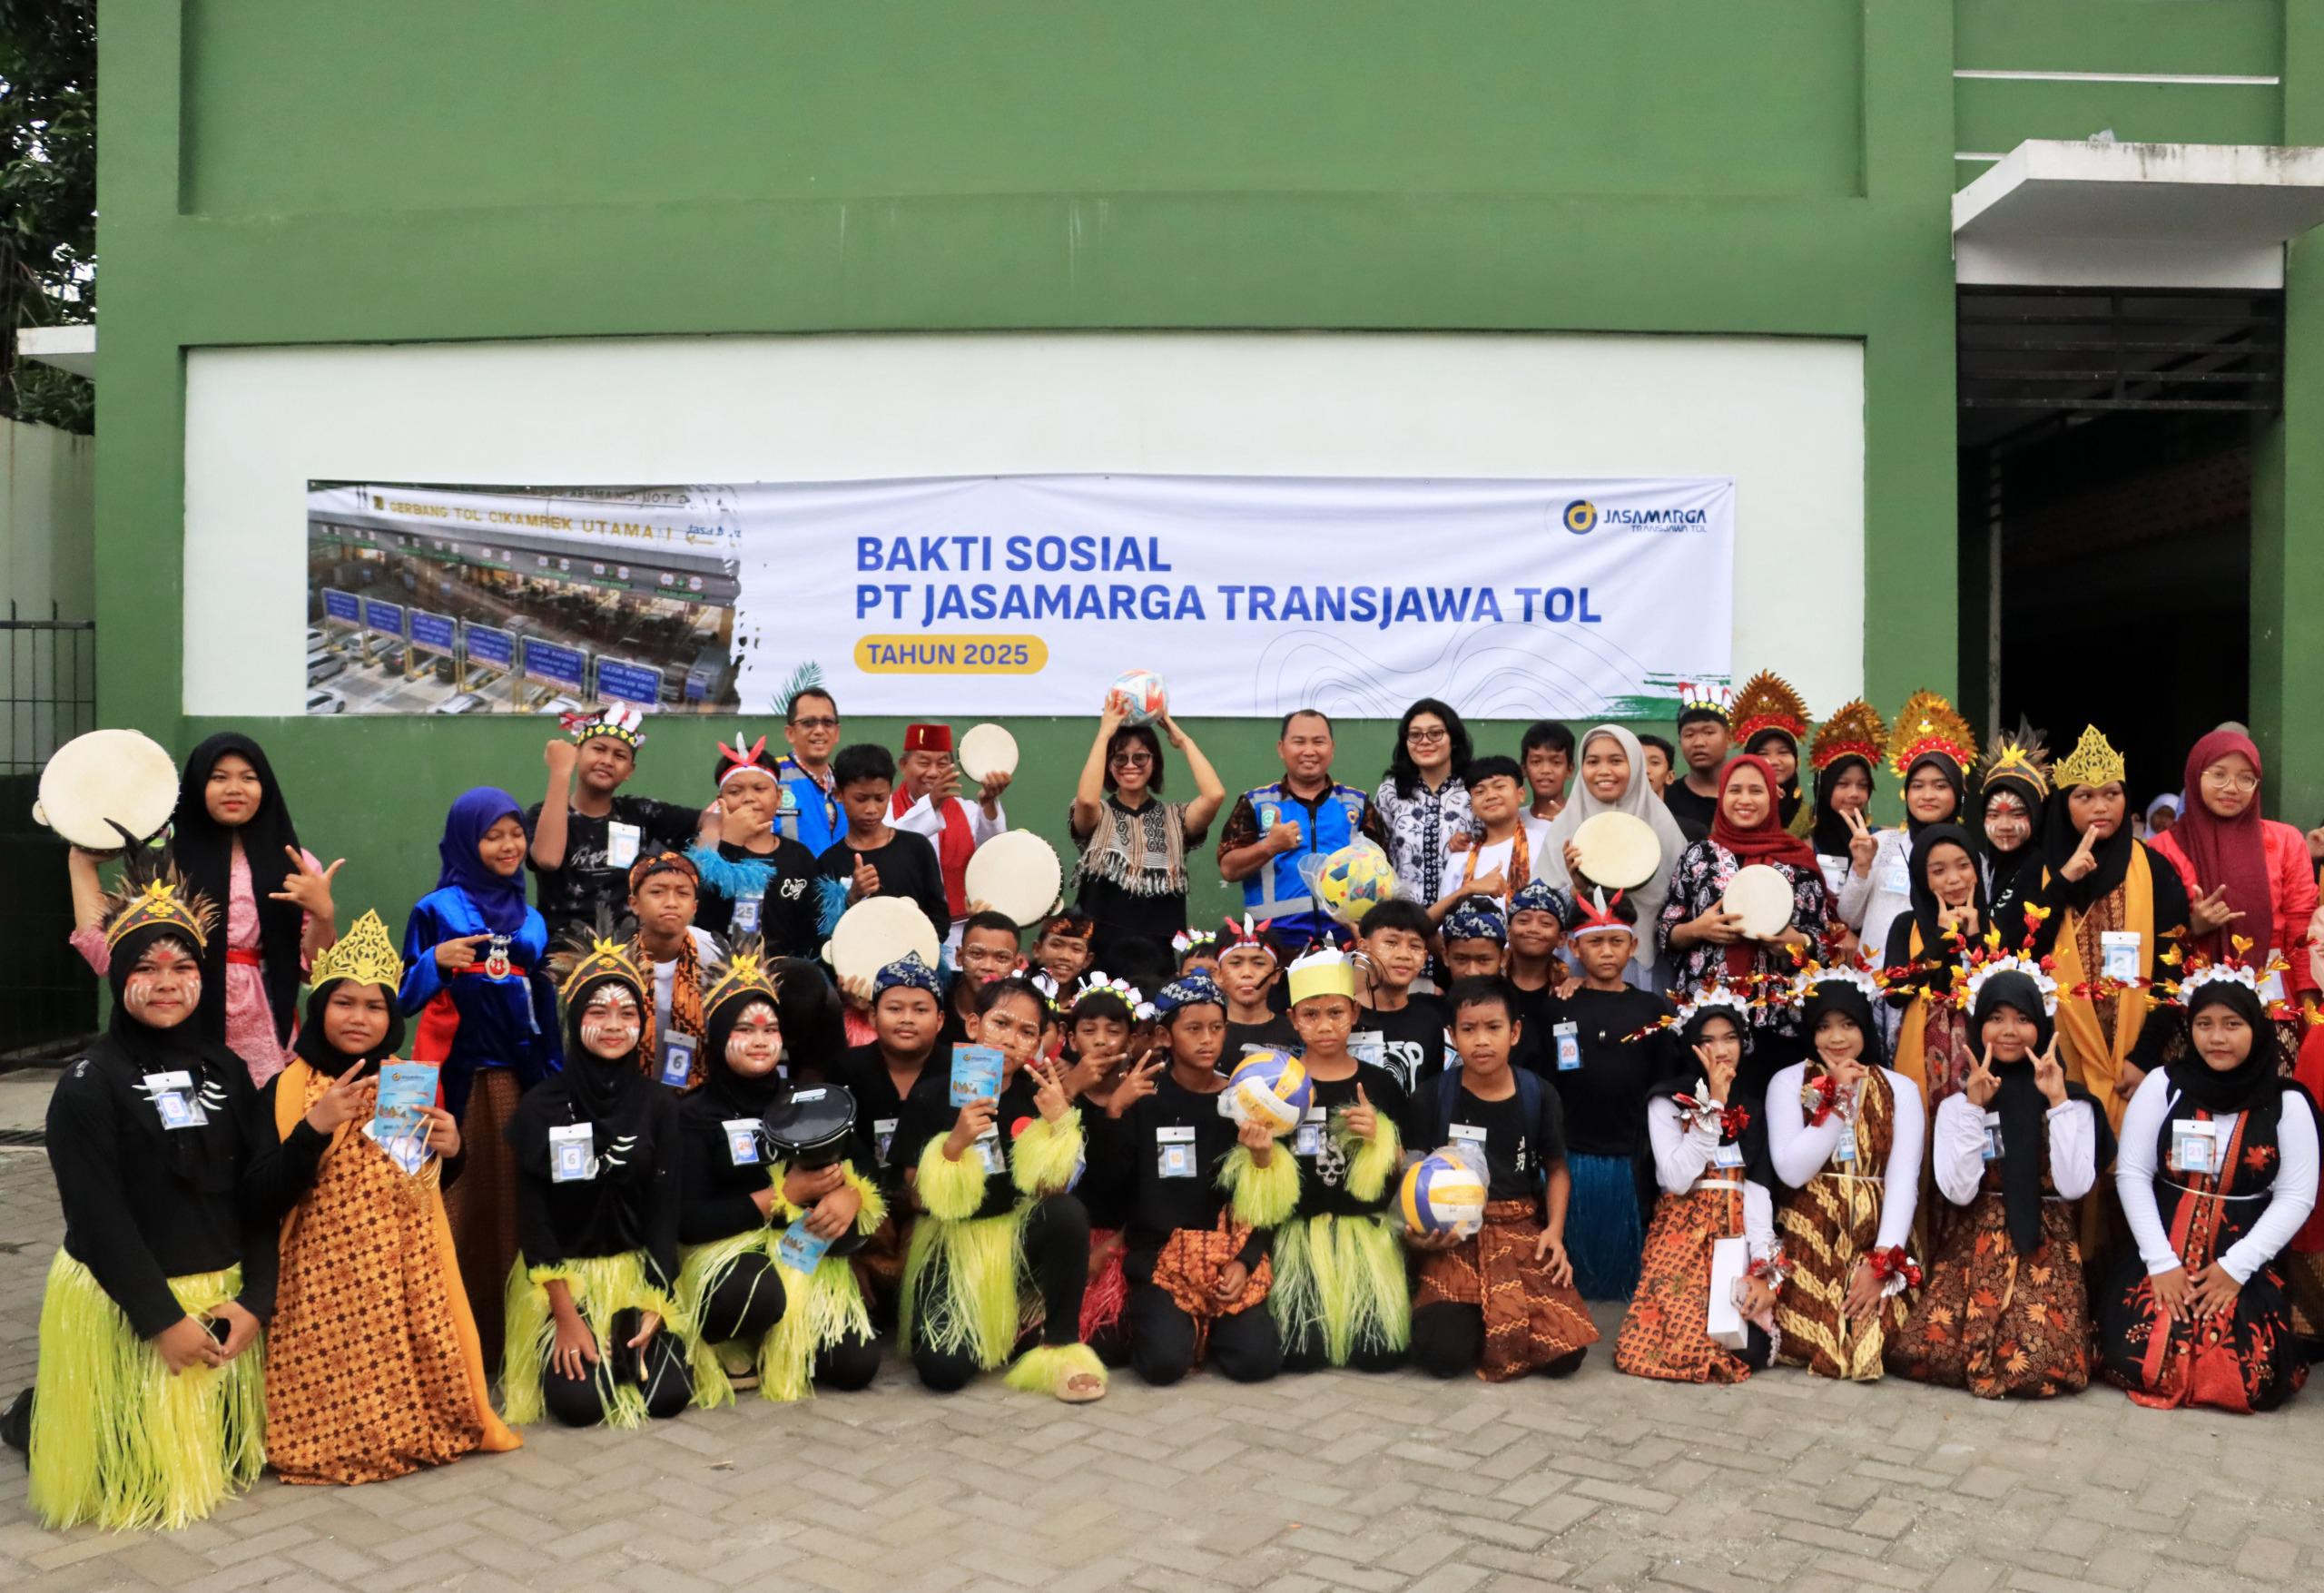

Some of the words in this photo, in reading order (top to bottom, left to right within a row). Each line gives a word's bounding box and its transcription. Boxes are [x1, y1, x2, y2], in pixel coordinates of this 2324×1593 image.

[389, 502, 448, 517] GERBANG
[455, 507, 481, 522] TOL
[487, 511, 573, 531] CIKAMPEK
[582, 519, 654, 539] UTAMA
[1603, 508, 1707, 524] JASAMARGA
[857, 536, 990, 572] BAKTI
[1006, 536, 1172, 572] SOSIAL
[856, 584, 911, 620] PT
[921, 584, 1206, 627] JASAMARGA
[1217, 585, 1502, 630] TRANSJAWA
[1514, 585, 1602, 623] TOL
[867, 644, 956, 665] TAHUN
[963, 644, 1029, 665] 2025
[736, 907, 753, 919] 25
[1561, 1046, 1576, 1057] 20
[673, 1054, 683, 1069] 6
[567, 1153, 576, 1165] 6
